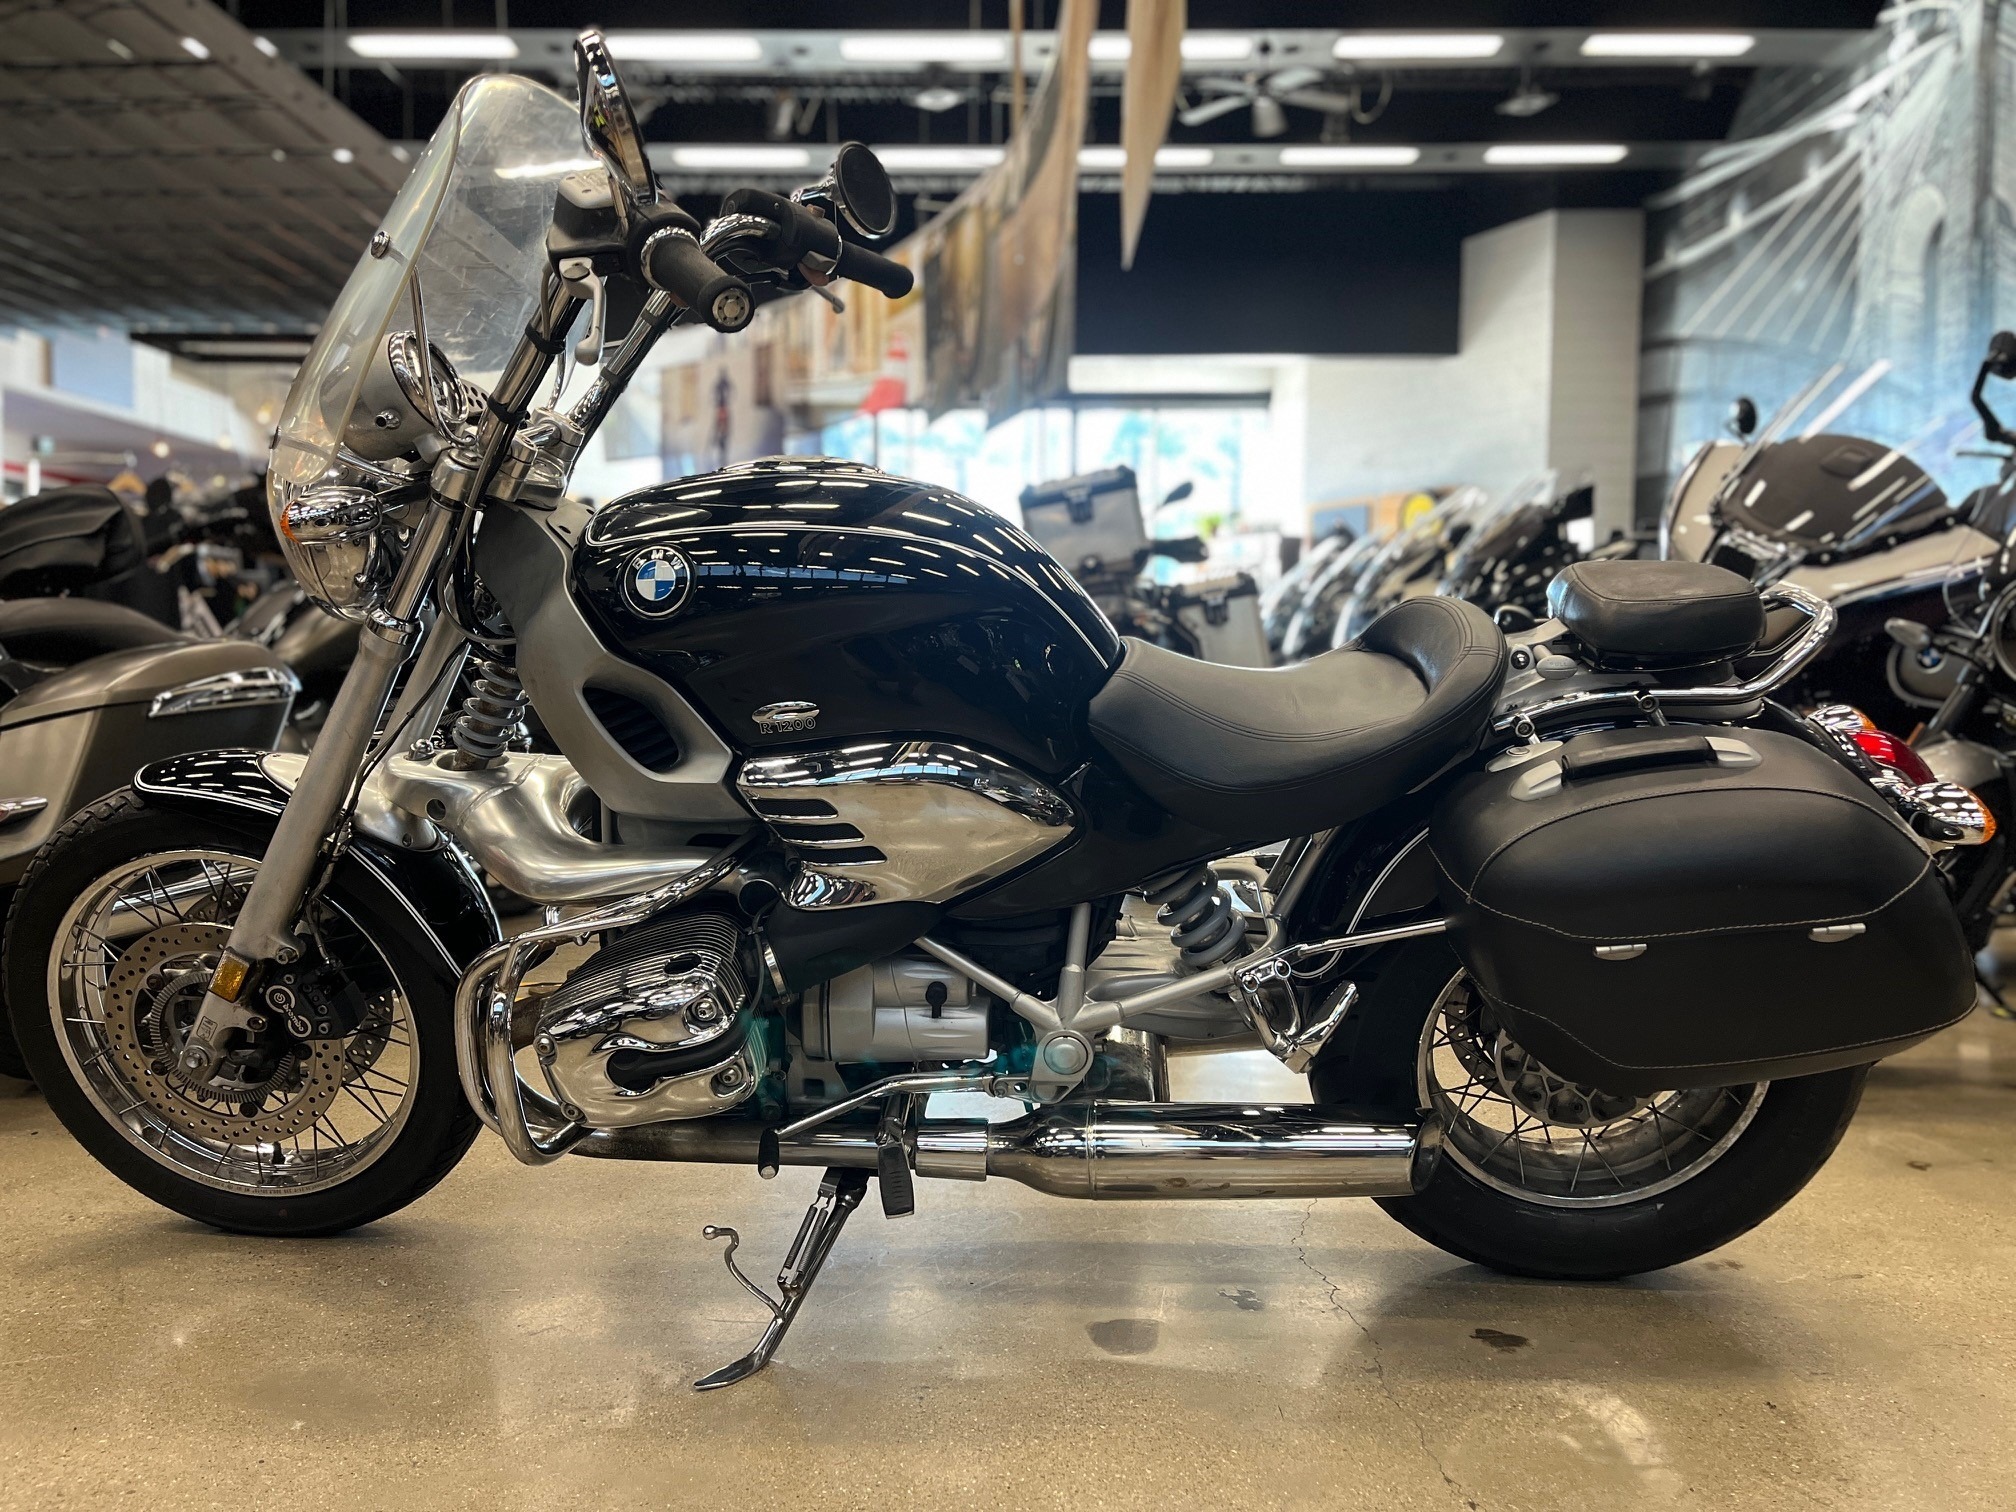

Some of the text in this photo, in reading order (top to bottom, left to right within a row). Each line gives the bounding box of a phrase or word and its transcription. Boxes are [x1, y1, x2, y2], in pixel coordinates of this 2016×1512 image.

[632, 549, 684, 570] BMW
[760, 716, 816, 734] R 1200
[282, 1003, 304, 1031] brembo
